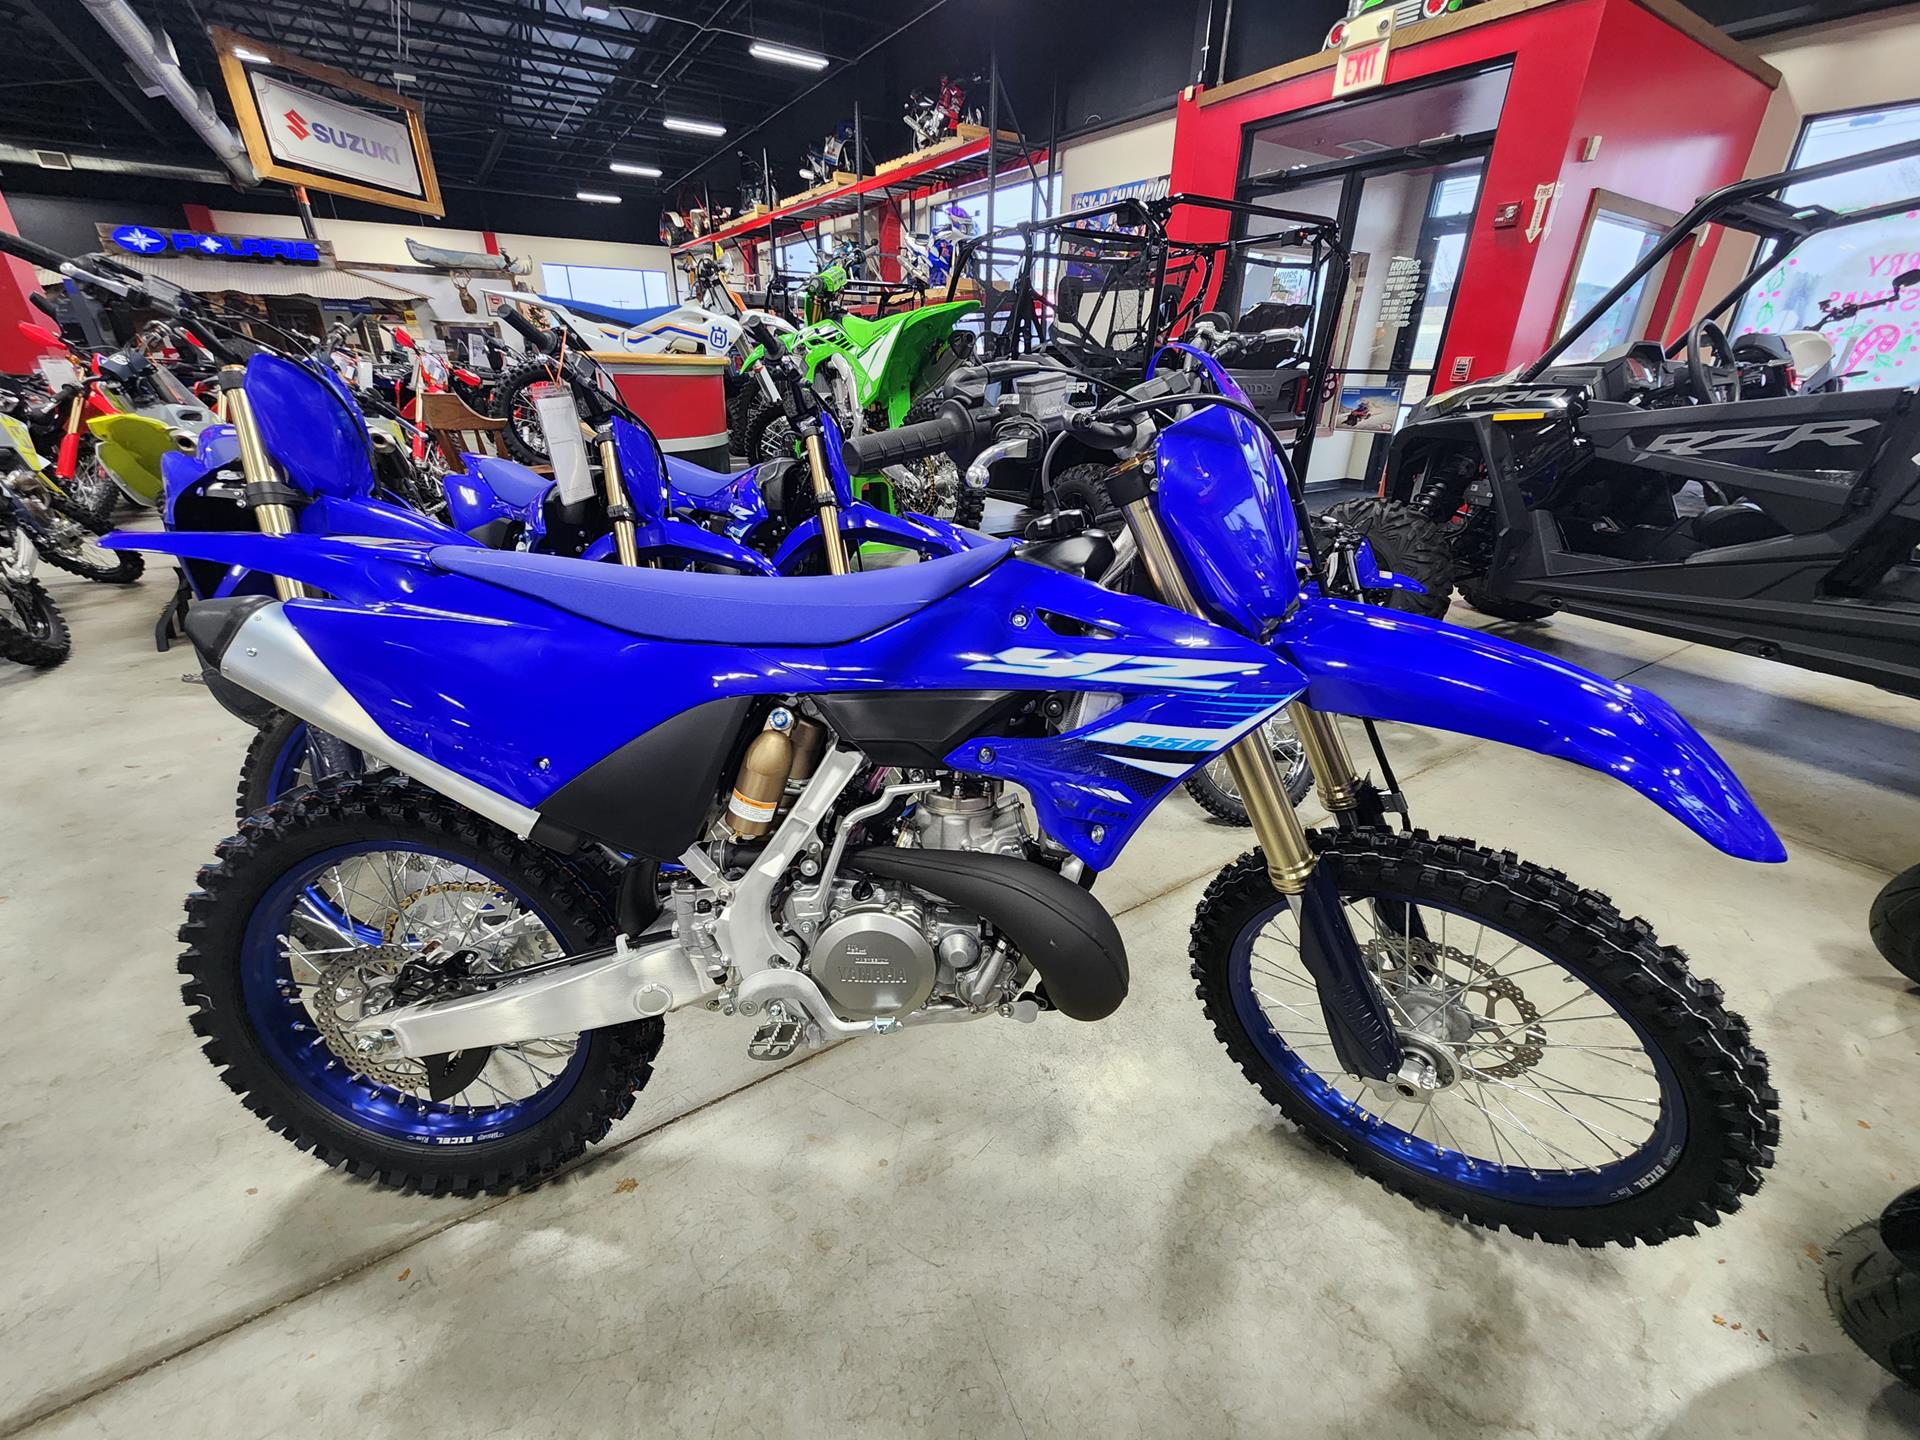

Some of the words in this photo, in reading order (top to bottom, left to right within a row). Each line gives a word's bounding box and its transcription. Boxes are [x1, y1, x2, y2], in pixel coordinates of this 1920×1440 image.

[1343, 47, 1381, 87] EXIT
[311, 122, 400, 165] SUZUKI
[1537, 186, 1553, 197] FIRE
[171, 231, 320, 261] POLARIS
[1390, 260, 1421, 272] HOURS
[1633, 419, 1881, 463] RZR
[962, 647, 1268, 690] YZ
[1127, 735, 1219, 751] 250
[436, 1136, 474, 1145] EXCEL
[1633, 1164, 1667, 1189] EXCEL
